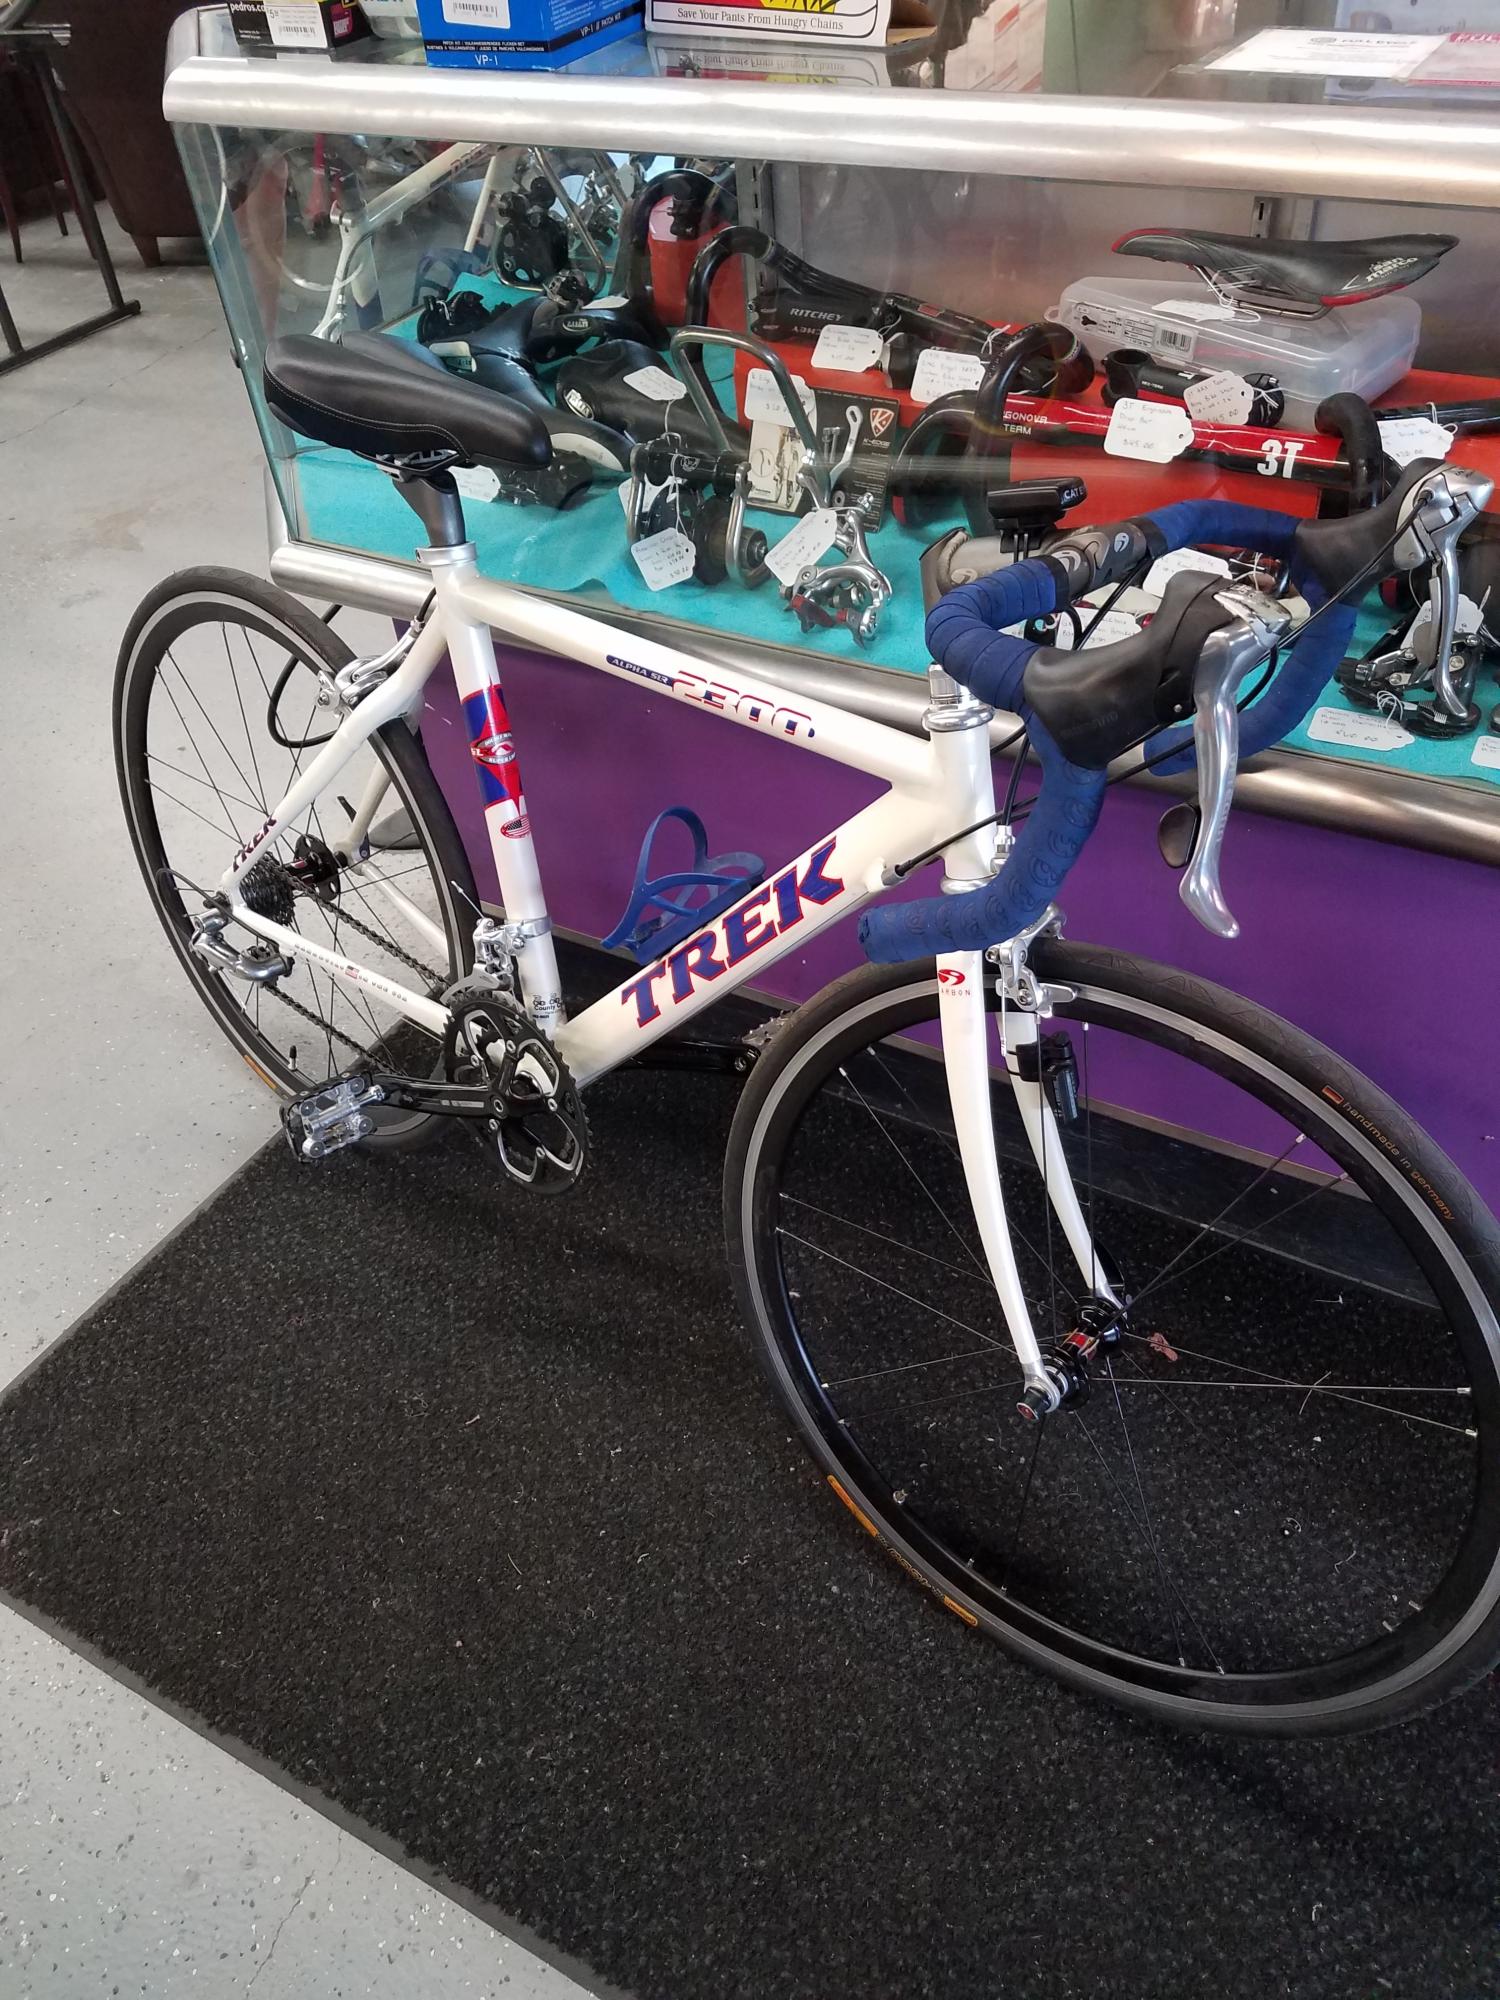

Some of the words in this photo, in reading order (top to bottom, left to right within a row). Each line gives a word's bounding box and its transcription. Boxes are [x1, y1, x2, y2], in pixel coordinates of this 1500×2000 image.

[230, 2, 266, 13] pedros.co
[677, 8, 698, 20] Save
[699, 9, 720, 21] Your
[721, 10, 745, 23] Pants
[747, 12, 771, 25] From
[774, 14, 808, 30] Hungry
[810, 17, 844, 31] Chains
[474, 54, 499, 66] VP-1
[789, 307, 846, 322] RITCHEY
[1256, 439, 1305, 479] 3T
[611, 656, 648, 677] ALPHA
[650, 671, 669, 686] SLR
[621, 835, 845, 1029] TREK
[940, 988, 971, 997] ARBON
[1342, 1101, 1400, 1156] handmade
[1400, 1156, 1412, 1169] in
[1410, 1170, 1456, 1221] germany
